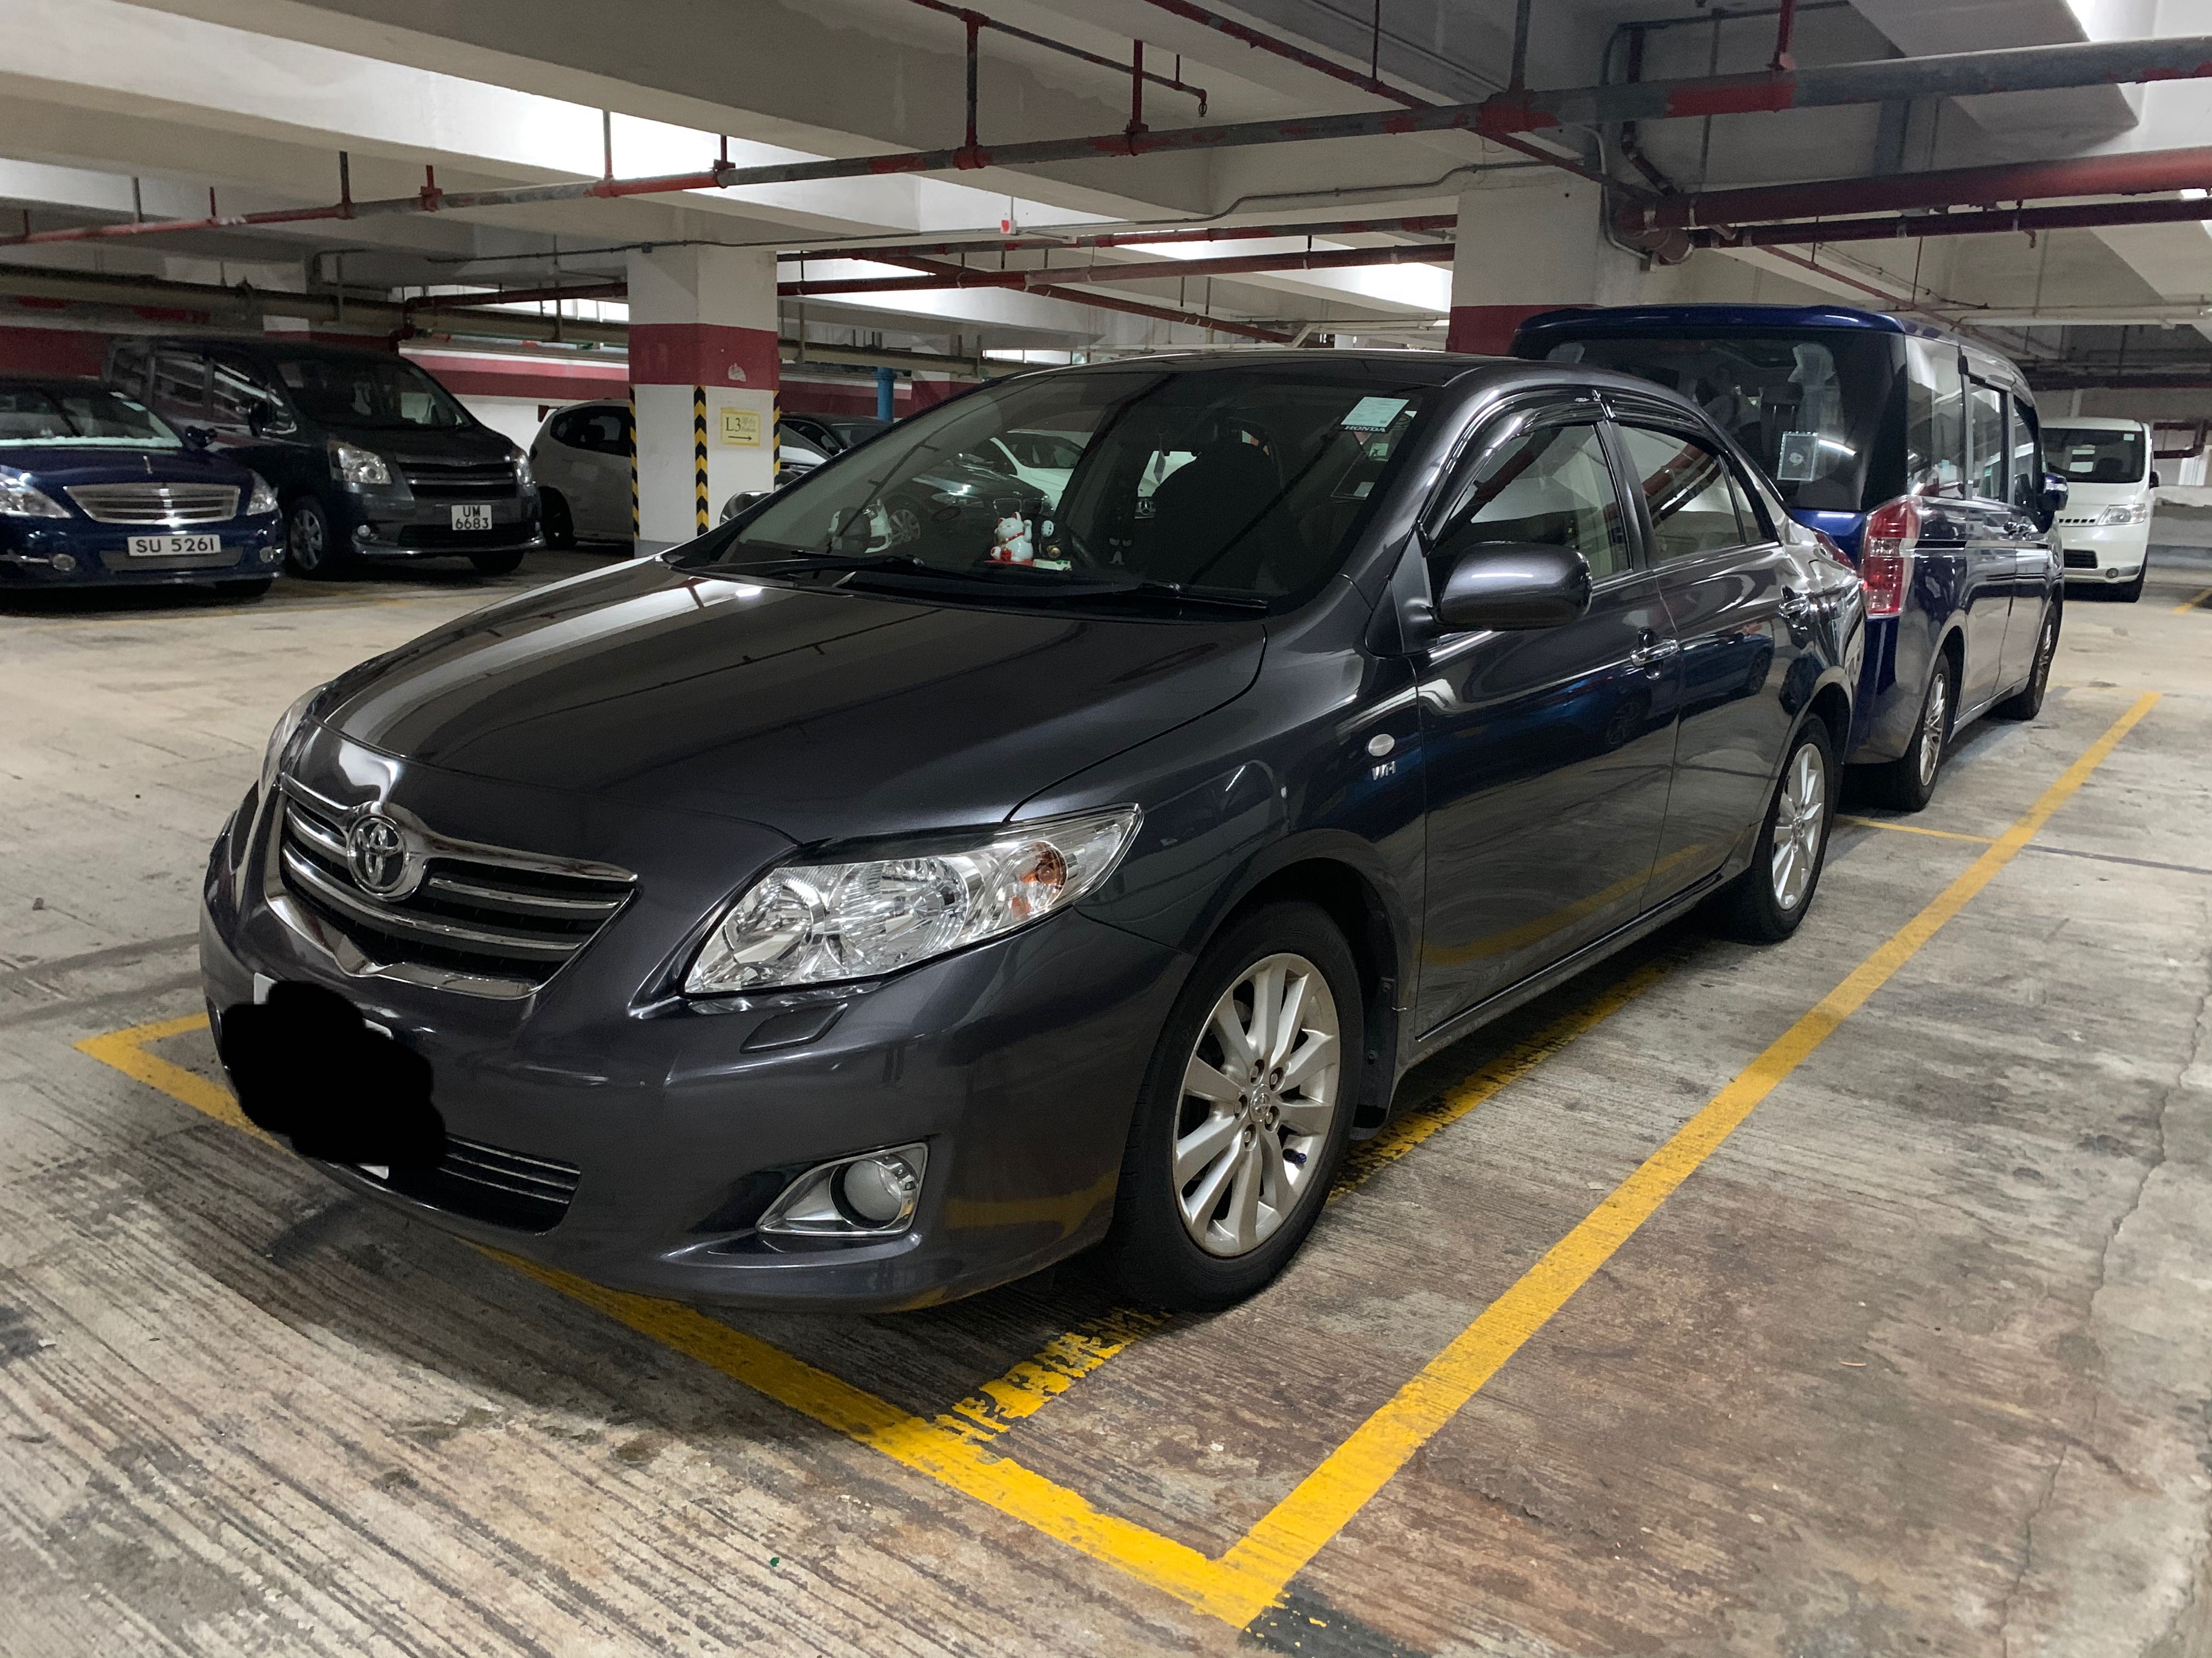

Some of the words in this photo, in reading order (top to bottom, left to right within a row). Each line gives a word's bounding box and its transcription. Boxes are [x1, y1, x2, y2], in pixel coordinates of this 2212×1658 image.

[726, 417, 741, 432] L3
[463, 505, 481, 517] UM
[455, 518, 489, 529] 6683
[136, 539, 161, 553] SU
[171, 537, 214, 552] 5261
